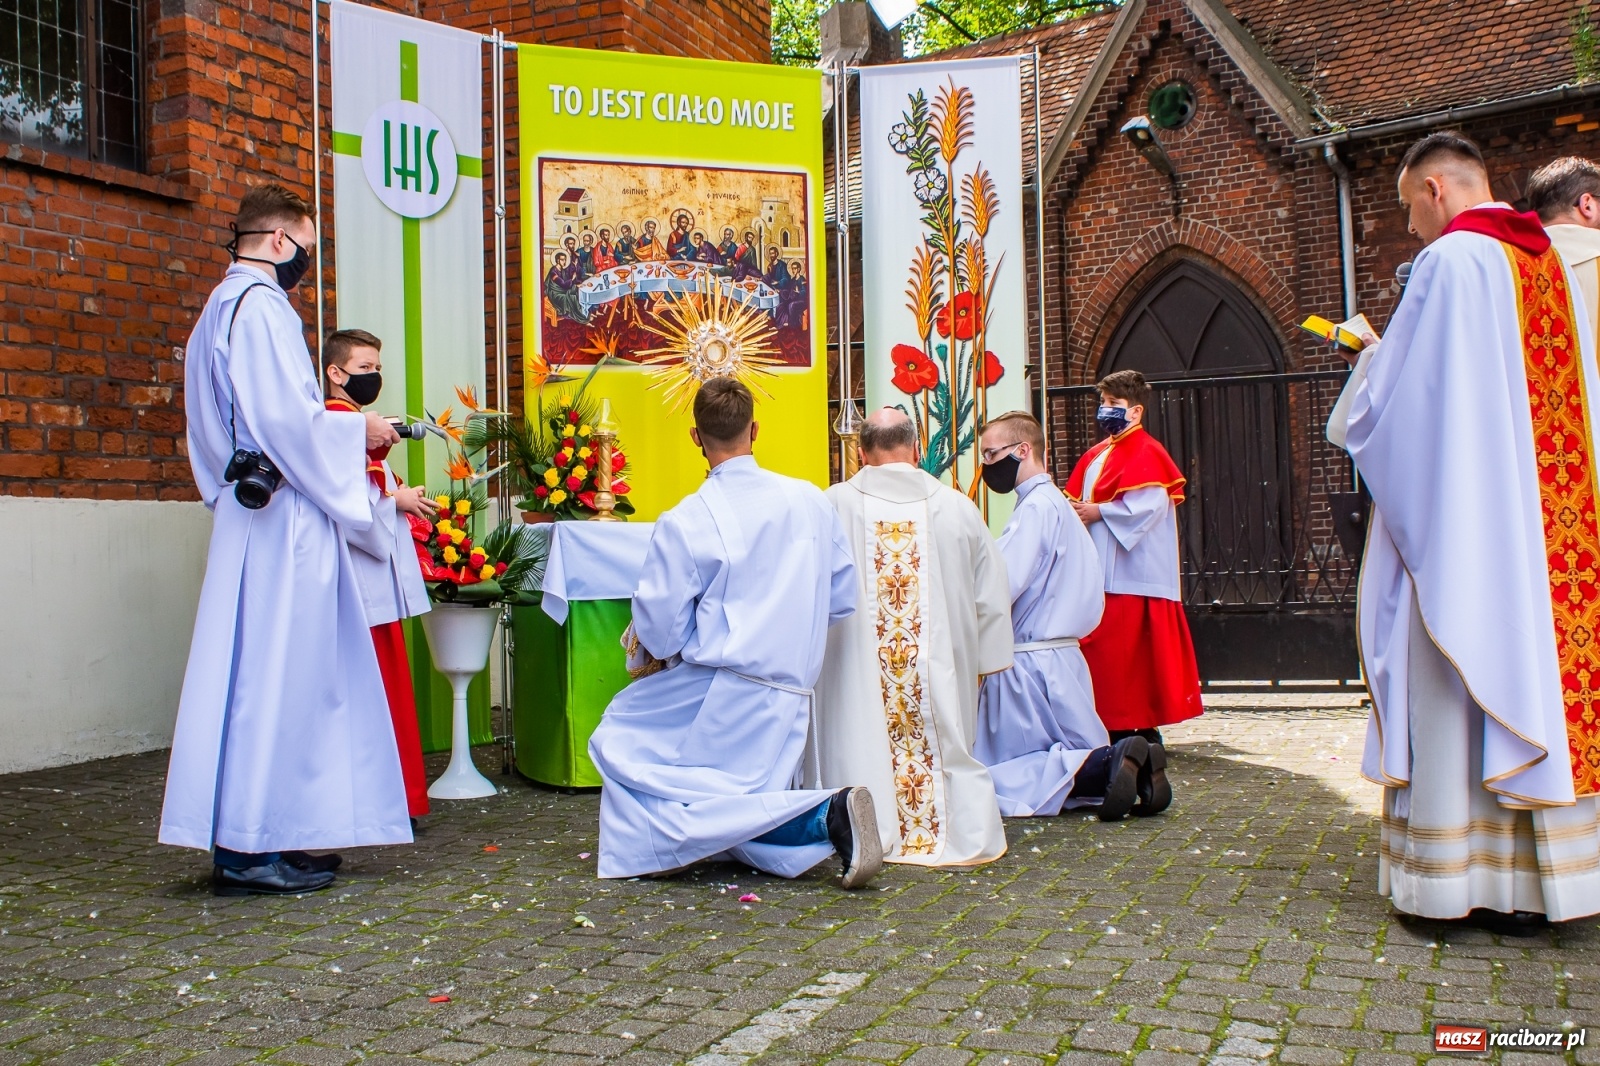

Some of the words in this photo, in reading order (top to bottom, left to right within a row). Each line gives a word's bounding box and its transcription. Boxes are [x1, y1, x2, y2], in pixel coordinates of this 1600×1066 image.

[548, 84, 583, 115] TO
[588, 87, 646, 119] JEST
[652, 92, 724, 125] CIAŁO
[730, 98, 795, 131] MOJE
[383, 119, 440, 195] IHS
